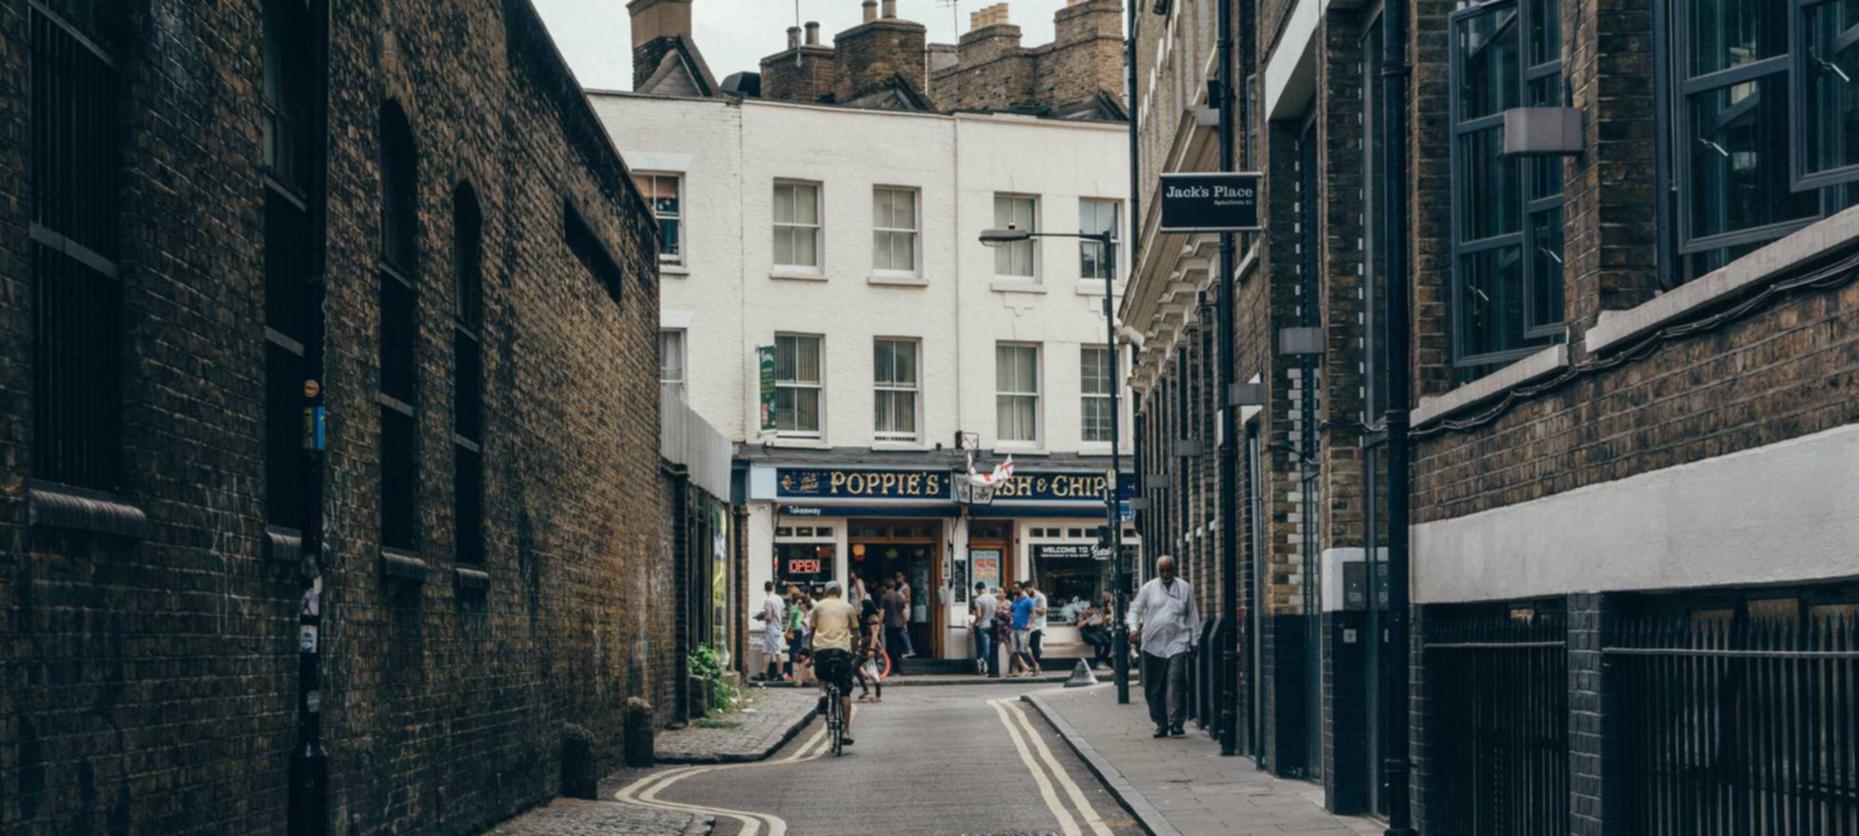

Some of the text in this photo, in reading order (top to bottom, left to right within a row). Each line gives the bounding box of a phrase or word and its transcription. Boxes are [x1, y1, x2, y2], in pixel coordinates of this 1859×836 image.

[1166, 186, 1253, 198] Jack's Place
[830, 471, 939, 495] POPPIE'S
[994, 475, 1033, 496] SH
[1036, 478, 1048, 492] &
[1051, 475, 1107, 497] CHIP
[1042, 546, 1077, 554] WELCOME
[1078, 546, 1088, 554] TO
[790, 560, 819, 573] OPEN
